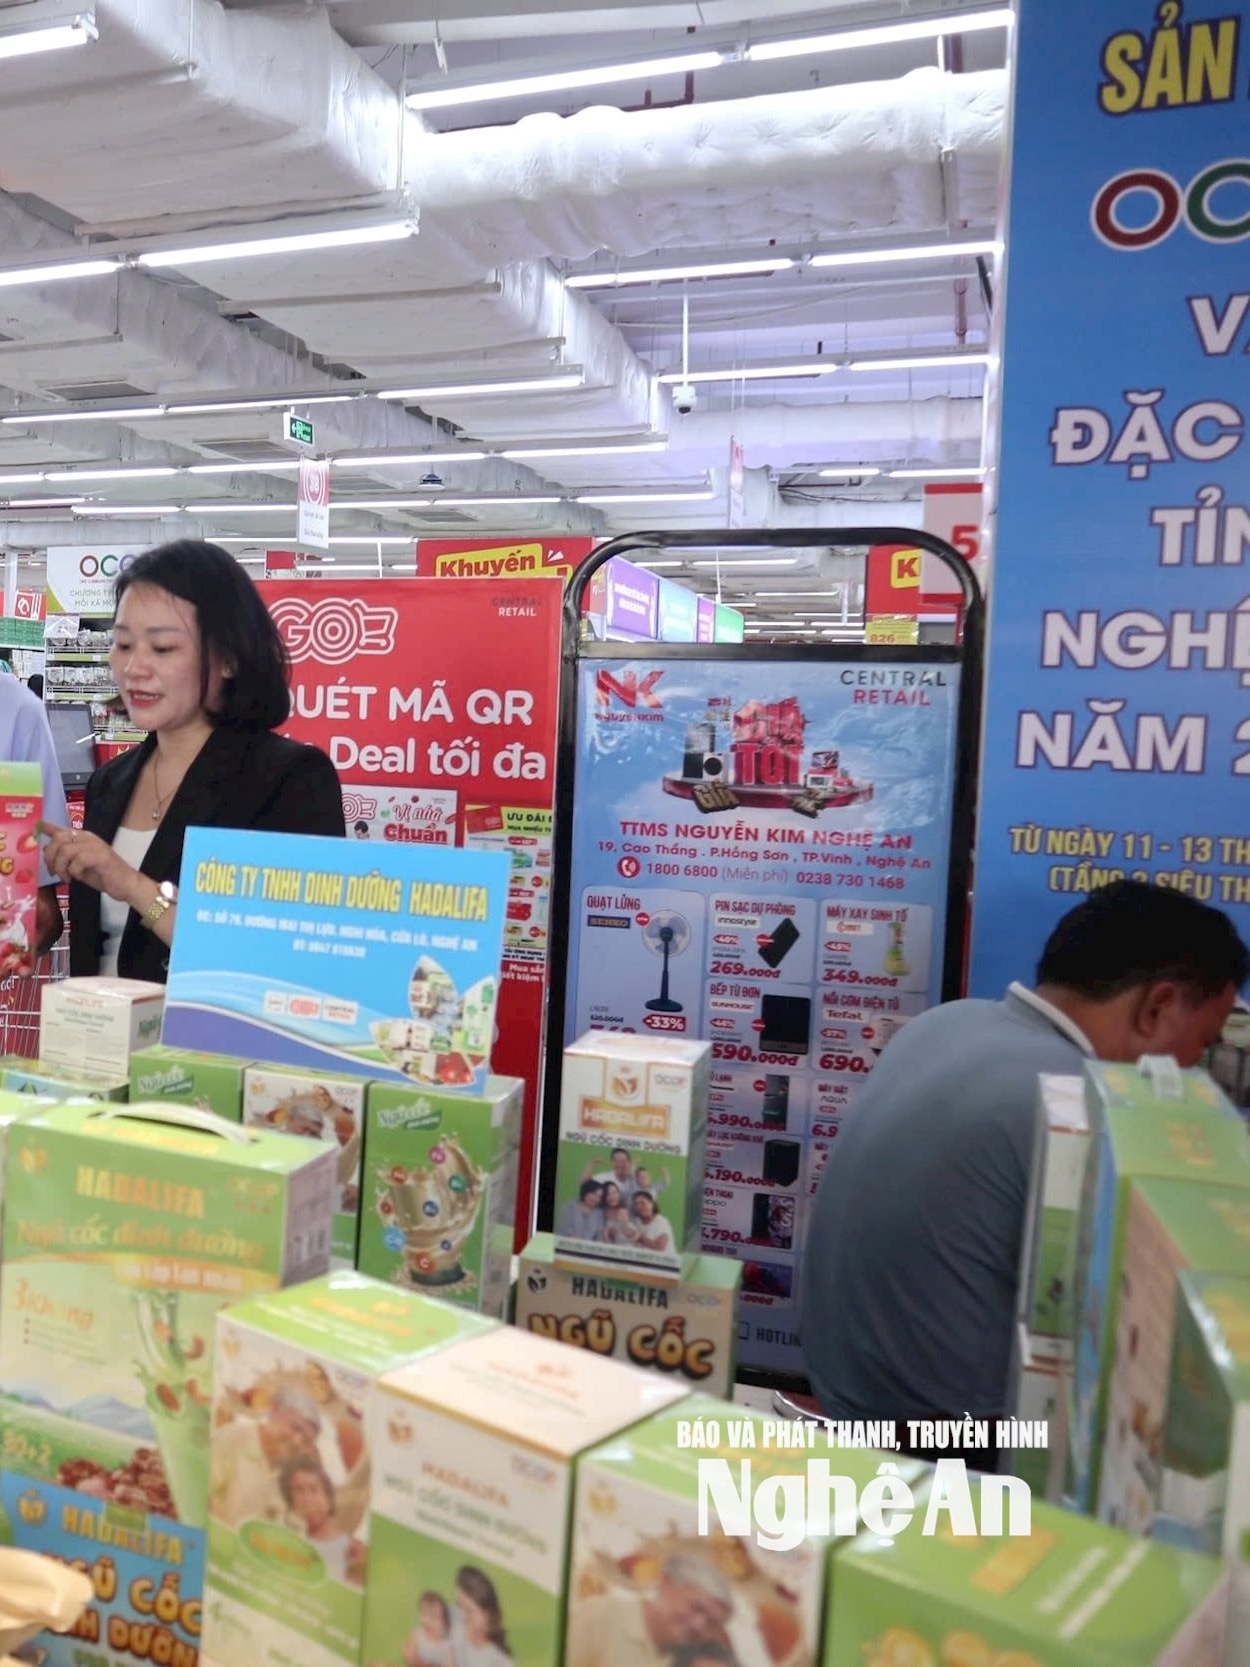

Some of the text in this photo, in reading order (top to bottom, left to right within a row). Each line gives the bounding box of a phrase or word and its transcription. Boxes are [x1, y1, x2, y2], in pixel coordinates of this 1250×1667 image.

[1101, 0, 1239, 114] SẢN
[1049, 389, 1244, 480] ĐẶC
[952, 525, 979, 560] 5
[440, 549, 536, 577] Khuyến
[498, 607, 537, 617] RETAIL
[840, 669, 947, 687] CENTRAL
[287, 676, 535, 726] UÉT MÃ QR
[854, 688, 932, 706] RETAIL
[1016, 697, 1208, 774] NĂM
[329, 735, 547, 780] Deal tối đa
[507, 813, 523, 821] ƯU
[384, 822, 448, 843] Chuẩn
[620, 820, 912, 851] TTMS NGUYỄN KIM NGHỆ AN
[1010, 823, 1042, 853] TỪ
[1047, 825, 1114, 857] NGÀY
[1123, 833, 1151, 859] 11
[1182, 837, 1212, 863] 13
[622, 842, 650, 854] Cao
[655, 843, 697, 858] Thắng
[763, 850, 789, 861] Sơn
[803, 852, 852, 865] TP.Vinh
[866, 856, 905, 869] Nghệ
[910, 858, 931, 869] An
[196, 856, 488, 921] CÔNG TY TNHH DINH DƯỠNG HADALIFA
[647, 863, 679, 875] 1800
[684, 865, 718, 878] 6800
[797, 872, 832, 886] 0238
[837, 874, 863, 887] 730
[869, 875, 906, 890] 1468
[587, 895, 612, 911] QUẠT
[715, 900, 730, 912] PIN
[732, 901, 749, 915] SẠC
[765, 902, 796, 916] PHÒNG
[826, 904, 847, 918] MÁY
[848, 906, 867, 920] XAY
[871, 908, 892, 921] SINH
[710, 961, 781, 979] 269.000đ
[822, 968, 899, 987] 349.000đ
[710, 982, 728, 996] BẾP
[730, 984, 741, 998] TỪ
[711, 1001, 754, 1010] SUNHOUSE
[827, 1009, 863, 1021] Tefal
[645, 1015, 684, 1031] -33%
[711, 1042, 800, 1067] 590.000đ
[528, 1308, 716, 1380] NGŨ CỐC
[128, 1571, 203, 1635] CỐC
